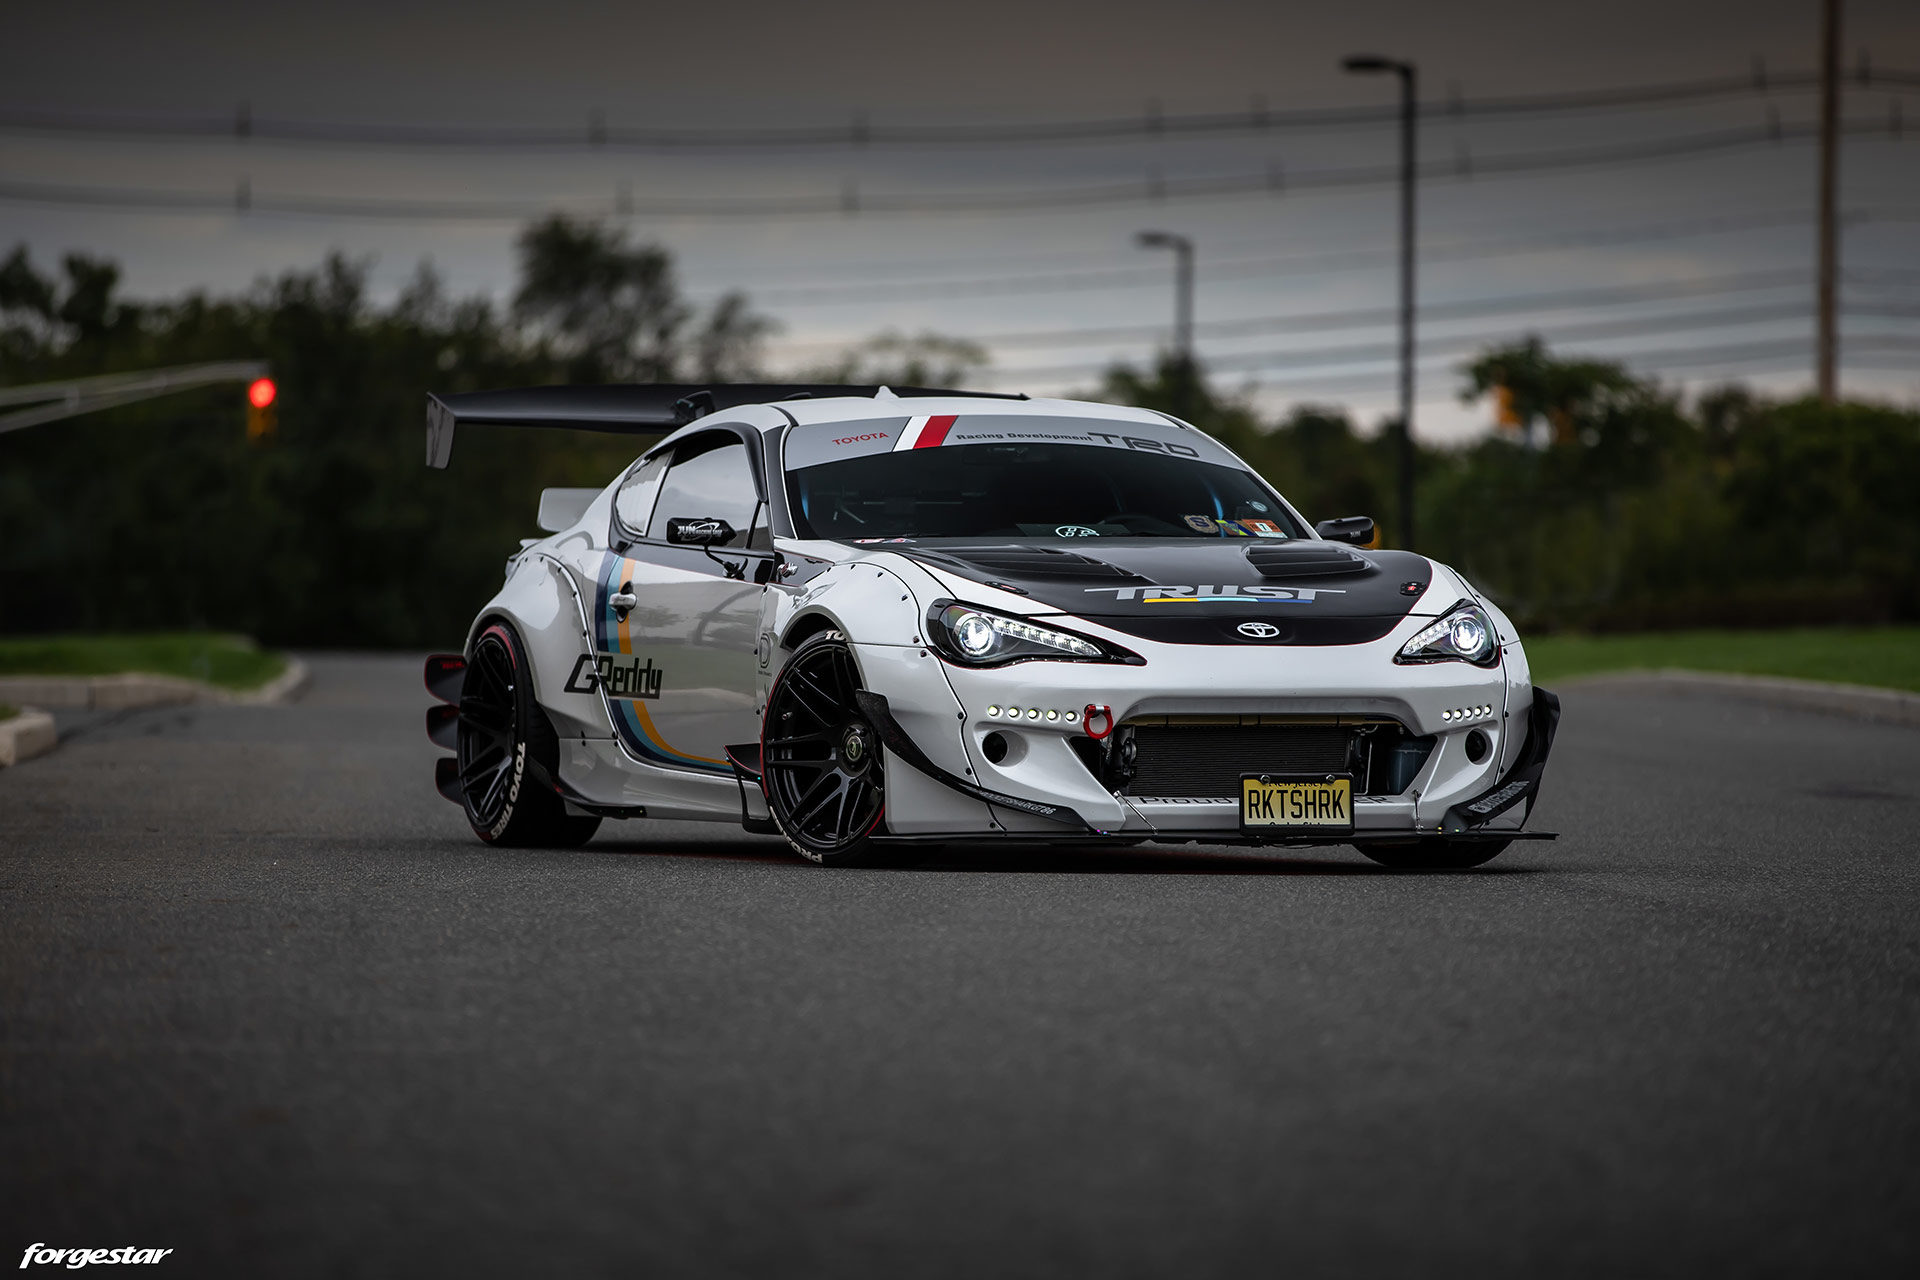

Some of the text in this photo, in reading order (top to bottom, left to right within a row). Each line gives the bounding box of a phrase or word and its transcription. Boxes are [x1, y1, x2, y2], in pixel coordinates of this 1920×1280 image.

[832, 432, 889, 446] TOYOTA
[956, 432, 1094, 442] Racing Development
[1087, 431, 1200, 458] TRD
[1084, 585, 1346, 600] TRUST
[563, 653, 663, 700] GReddy
[490, 742, 526, 840] TOYO TIRES
[1247, 789, 1345, 819] RKTSHRK
